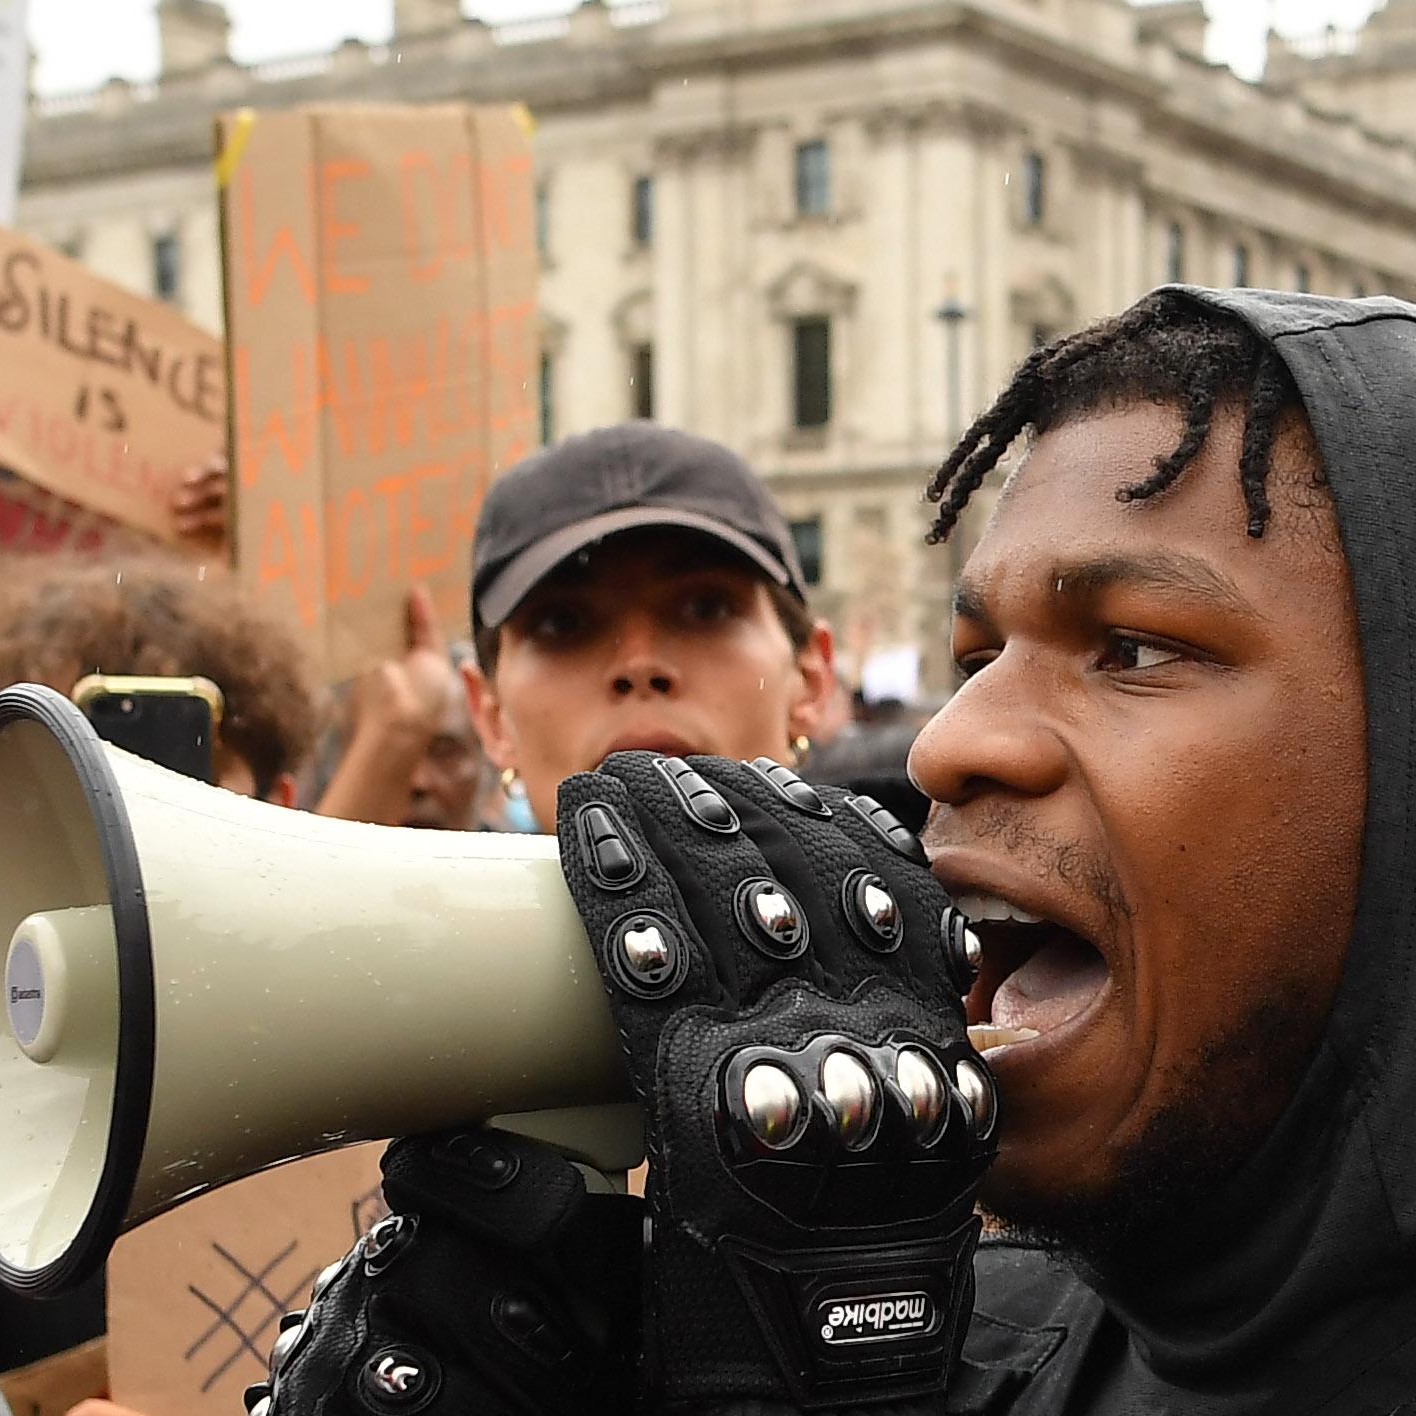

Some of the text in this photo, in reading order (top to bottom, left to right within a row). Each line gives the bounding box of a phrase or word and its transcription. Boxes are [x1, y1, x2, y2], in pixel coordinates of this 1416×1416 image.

[237, 158, 371, 306] WE
[73, 384, 129, 433] IS
[827, 1296, 927, 1331] madbike
